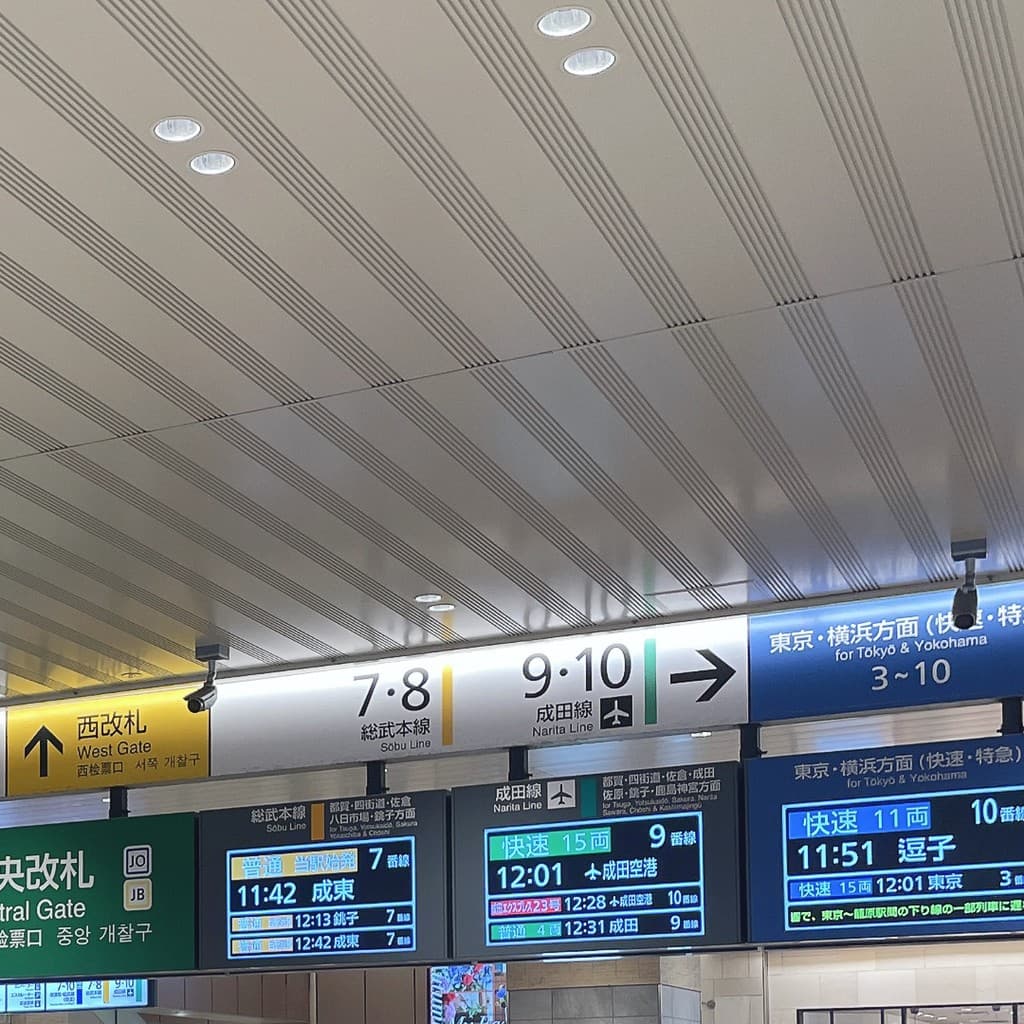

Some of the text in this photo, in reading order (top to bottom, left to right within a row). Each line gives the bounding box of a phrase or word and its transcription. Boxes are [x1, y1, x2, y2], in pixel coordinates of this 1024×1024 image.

[835, 650, 853, 662] for
[900, 644, 910, 654] &
[915, 634, 988, 652] Yokohama
[536, 700, 593, 722] 成田線
[77, 708, 147, 740] 西改札
[361, 718, 431, 742] 総武本線
[532, 722, 594, 737] Narita Line
[77, 740, 152, 759] West Gate
[409, 738, 432, 751] Line
[164, 753, 201, 769] 개찰구
[847, 777, 861, 789] for
[898, 774, 906, 784] &
[910, 769, 968, 783] Yokohama
[495, 783, 542, 802] 成田線
[251, 805, 306, 824] 総武本線
[493, 801, 542, 814] Narita Line
[289, 821, 306, 831] Line
[803, 809, 858, 838] 快速
[875, 805, 929, 829] 11両
[502, 833, 550, 859] 快速
[562, 830, 611, 852] 15両
[798, 835, 957, 870] 11:51 逗子
[128, 854, 146, 868] JO
[242, 856, 283, 878] 普通
[497, 857, 658, 889] 12:01 成田空港
[130, 887, 145, 901] JB
[237, 878, 355, 907] 11:42 成東
[799, 881, 832, 897] 快速
[876, 875, 923, 893] 12:01
[928, 873, 963, 890] 東京
[36, 899, 86, 921] Gate
[564, 895, 606, 912] 12:28
[619, 893, 653, 907] 成田空港
[295, 913, 331, 928] 12:13
[333, 911, 359, 926] 銚子
[564, 920, 605, 936] 12:31
[609, 918, 638, 933] 成田
[56, 922, 153, 946] 중앙 개찰구
[295, 936, 332, 950] 12:42
[333, 934, 360, 949] 成東
